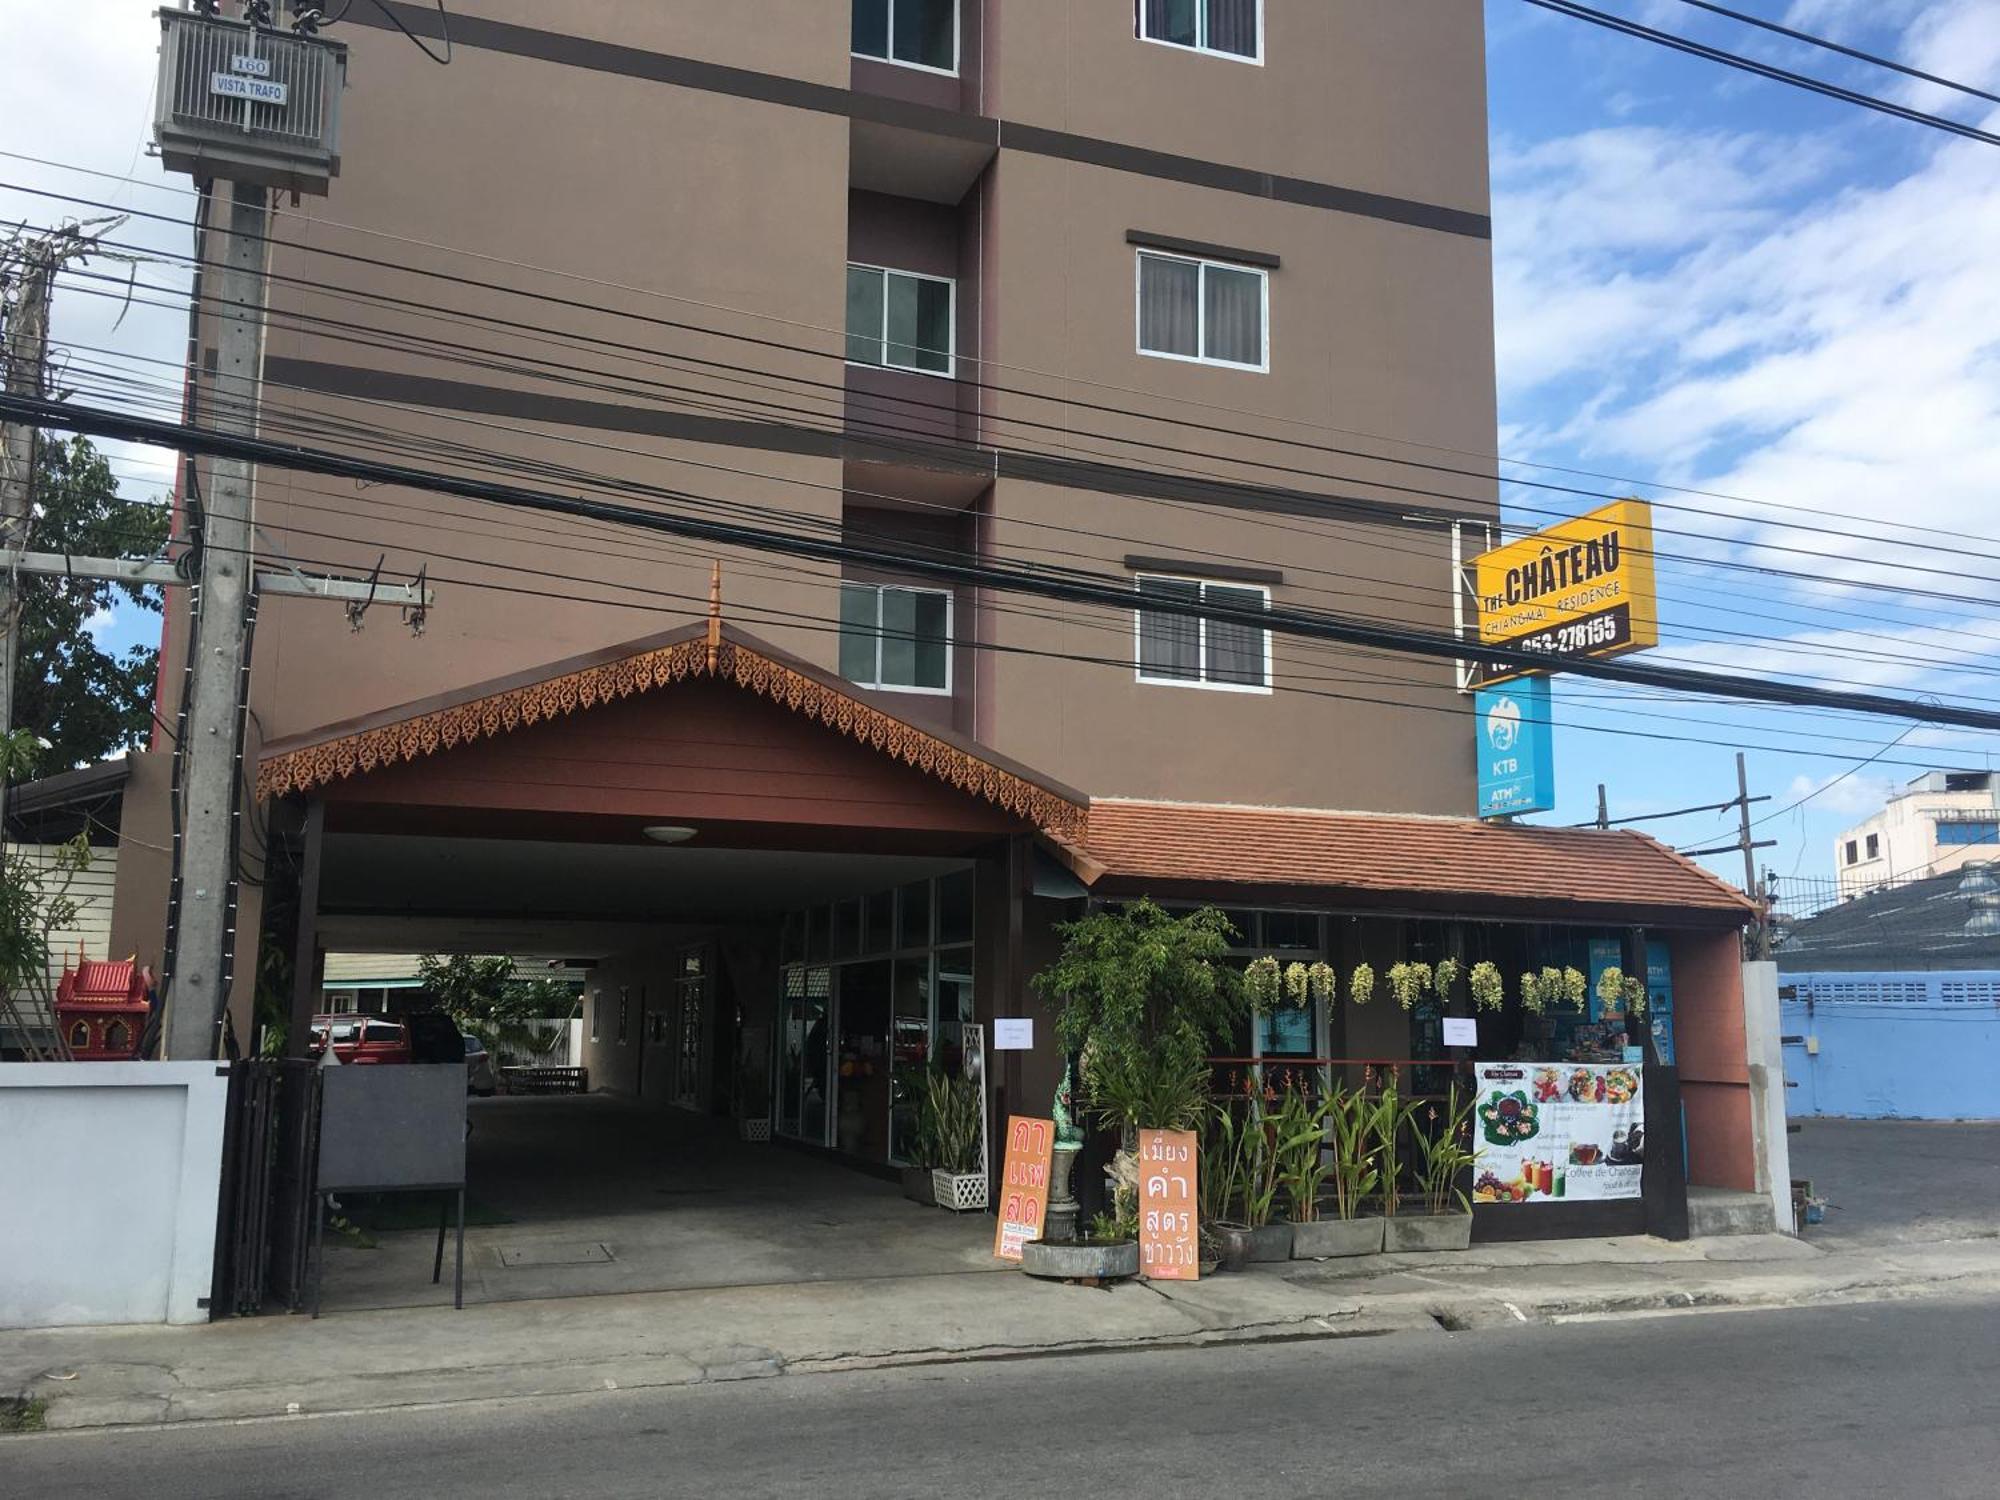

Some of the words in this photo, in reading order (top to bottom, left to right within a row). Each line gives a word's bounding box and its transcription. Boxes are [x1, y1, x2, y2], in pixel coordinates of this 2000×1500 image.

[237, 59, 266, 73] 160
[217, 77, 246, 94] VISTA
[249, 82, 281, 100] TRAFO
[1483, 593, 1503, 614] THE
[1505, 530, 1620, 606] CHÂTEAU
[1557, 580, 1620, 612] RESIDENCE
[1492, 758, 1518, 776] KTB
[1491, 786, 1513, 802] ATM
[1013, 1120, 1046, 1155] กา
[1147, 1167, 1188, 1199] คำ
[1146, 1210, 1190, 1240] สูตร
